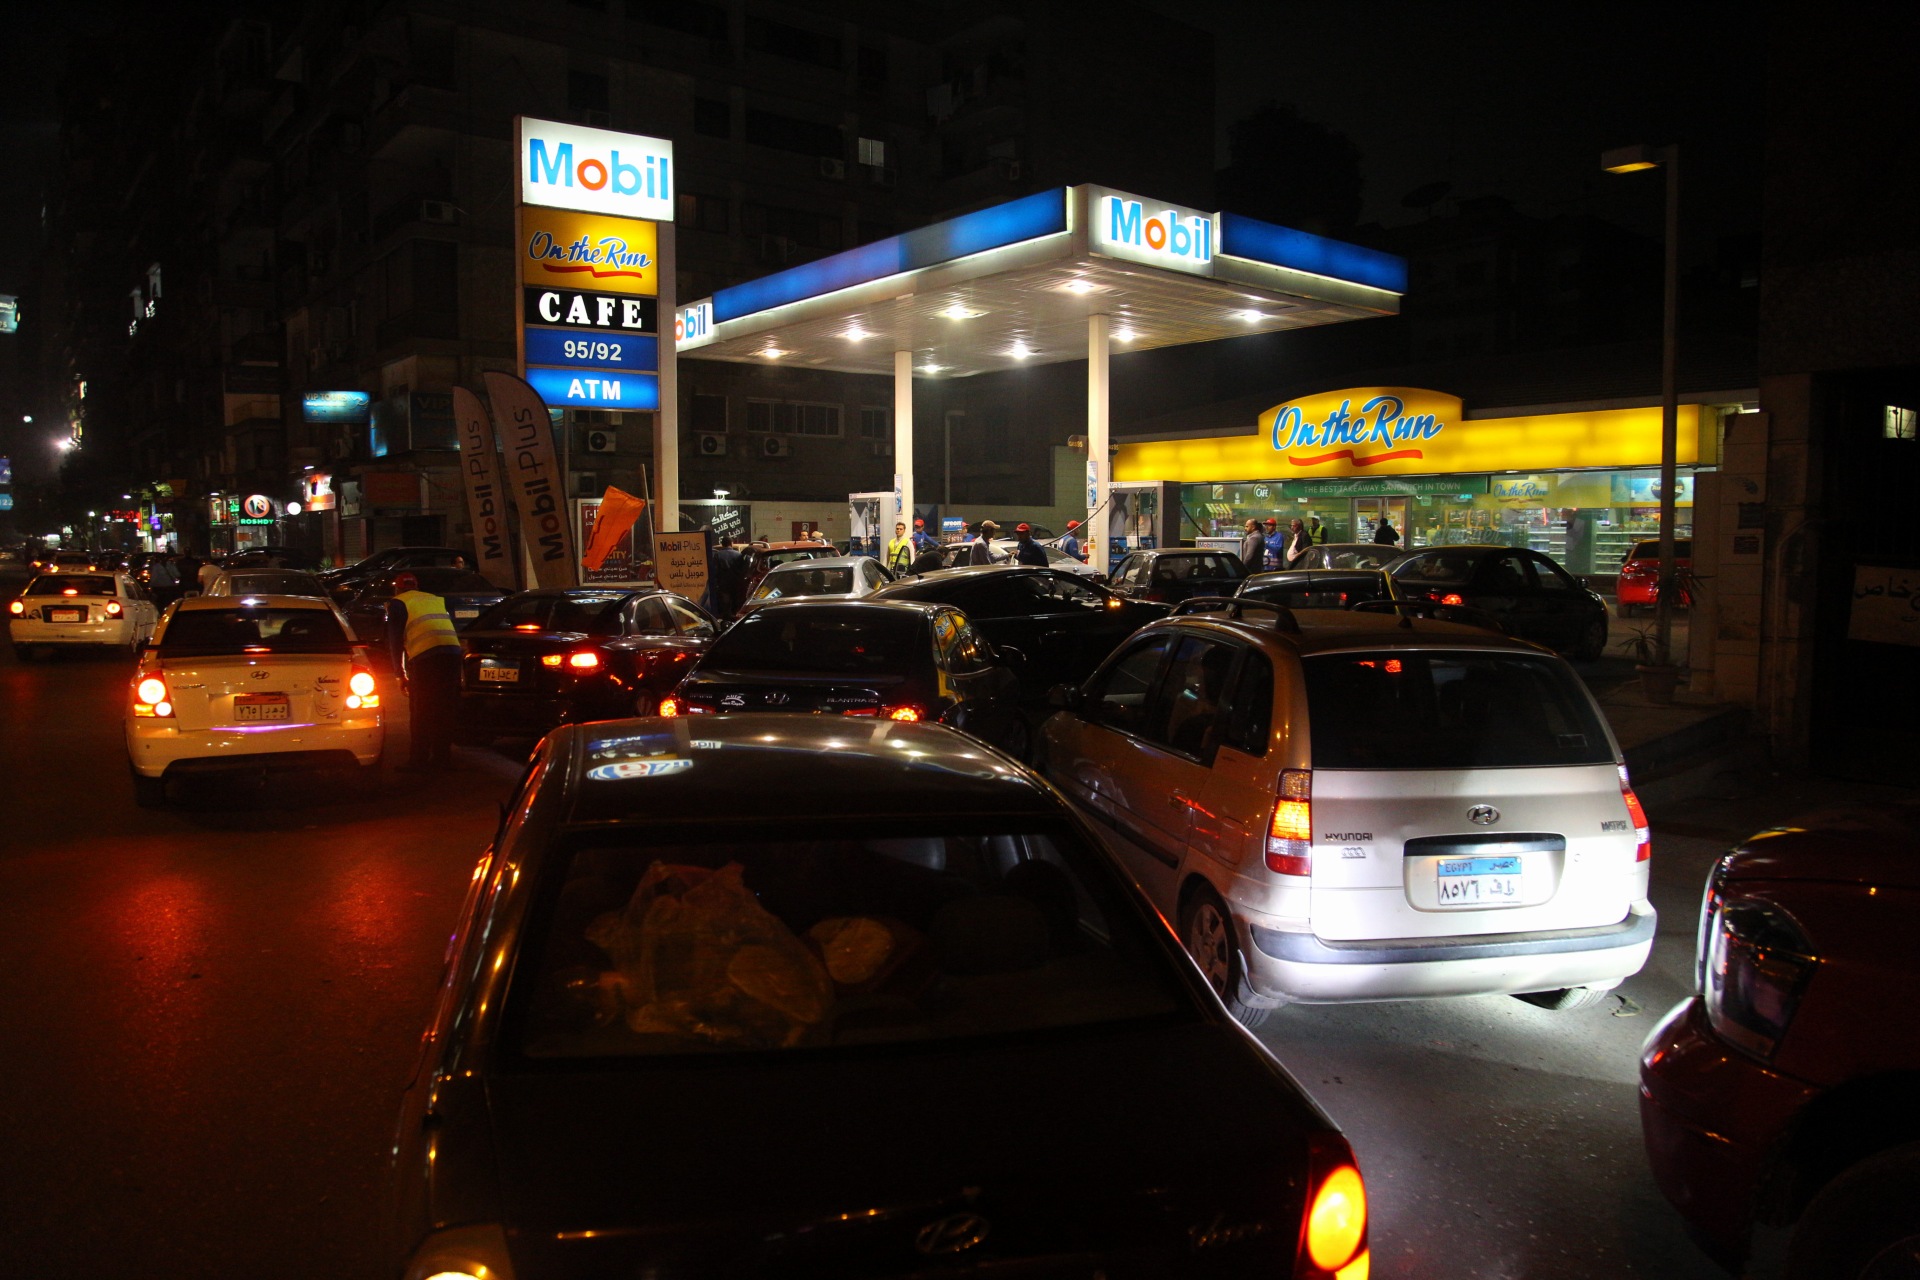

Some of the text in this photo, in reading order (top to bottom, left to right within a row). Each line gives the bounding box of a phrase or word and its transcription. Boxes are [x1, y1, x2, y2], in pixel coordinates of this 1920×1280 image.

[529, 138, 669, 201] Mobil
[1109, 196, 1211, 262] Mobil
[527, 231, 653, 269] On the Run
[539, 292, 642, 328] CAFE
[564, 340, 622, 361] 95/92
[305, 392, 318, 401] VIP
[567, 378, 621, 400] ATM
[1271, 395, 1444, 450] On the Run
[467, 419, 503, 560] Mobil Plus
[513, 407, 565, 562] Mobil Plus
[1338, 485, 1379, 493] TAKEAWAY
[1381, 484, 1423, 492] SANDWICH
[1493, 484, 1506, 498] On
[1505, 482, 1523, 496] the
[660, 540, 701, 552] Mobil Plus
[1324, 832, 1373, 841] HYUNDAI
[1445, 862, 1473, 873] EGYPT
[1440, 879, 1480, 900] ٨٥٧٦
